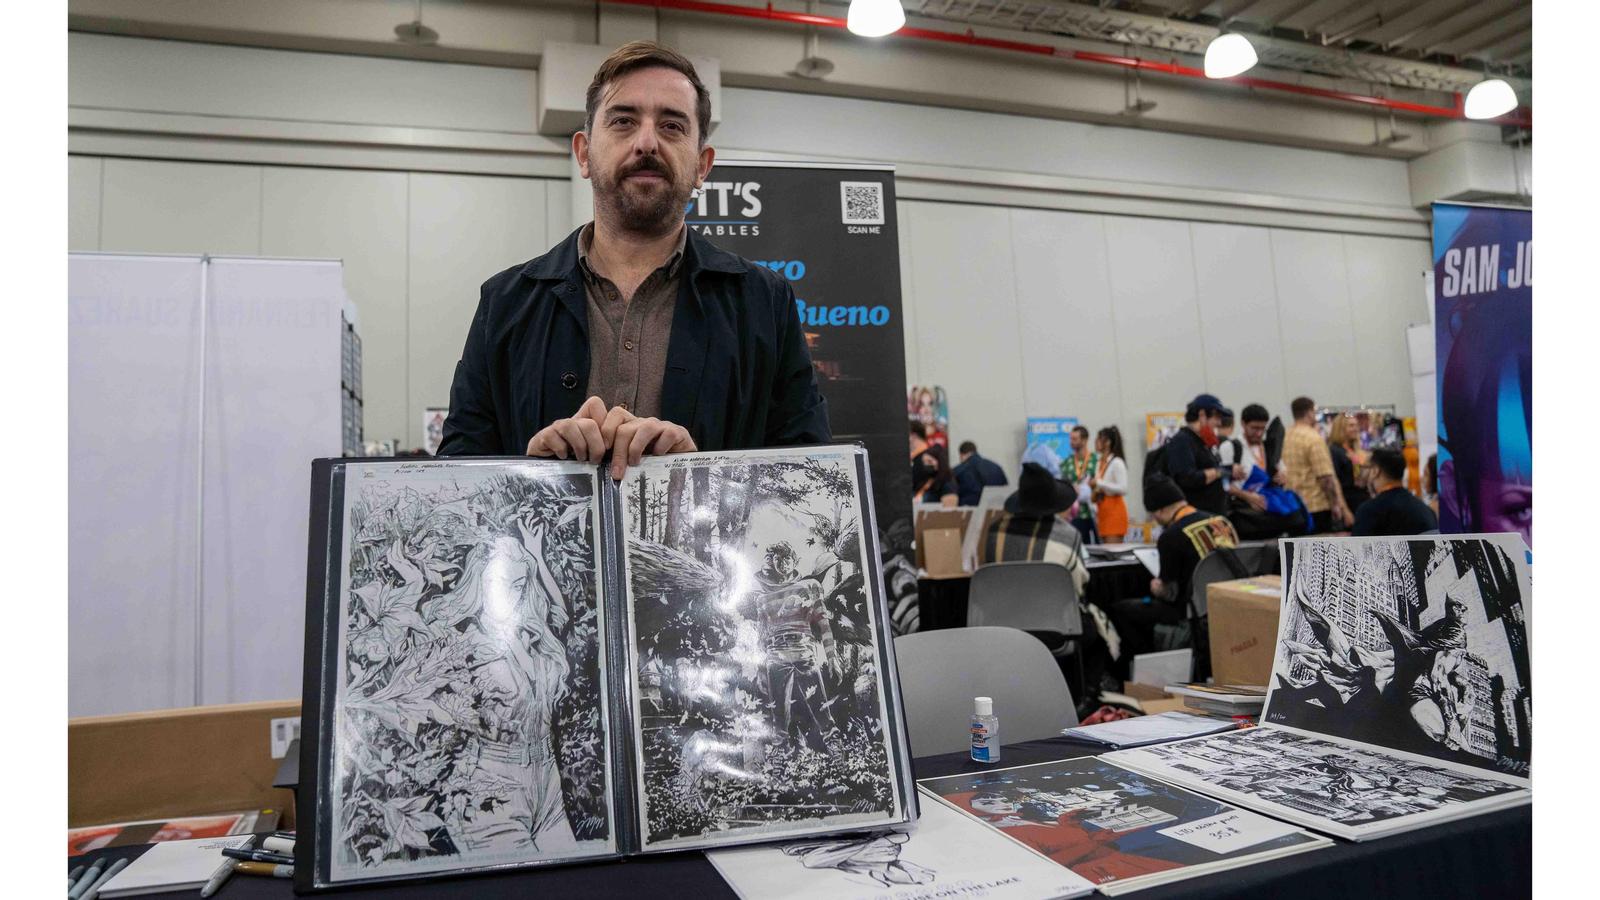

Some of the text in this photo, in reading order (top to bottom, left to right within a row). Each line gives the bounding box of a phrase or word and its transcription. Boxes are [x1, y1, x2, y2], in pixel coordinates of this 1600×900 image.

[686, 182, 762, 218] TT'S
[847, 226, 881, 235] SCAN ME
[1442, 244, 1500, 298] SAM
[935, 889, 958, 898] ON
[959, 884, 984, 893] THE
[987, 876, 1023, 889] LAKE
